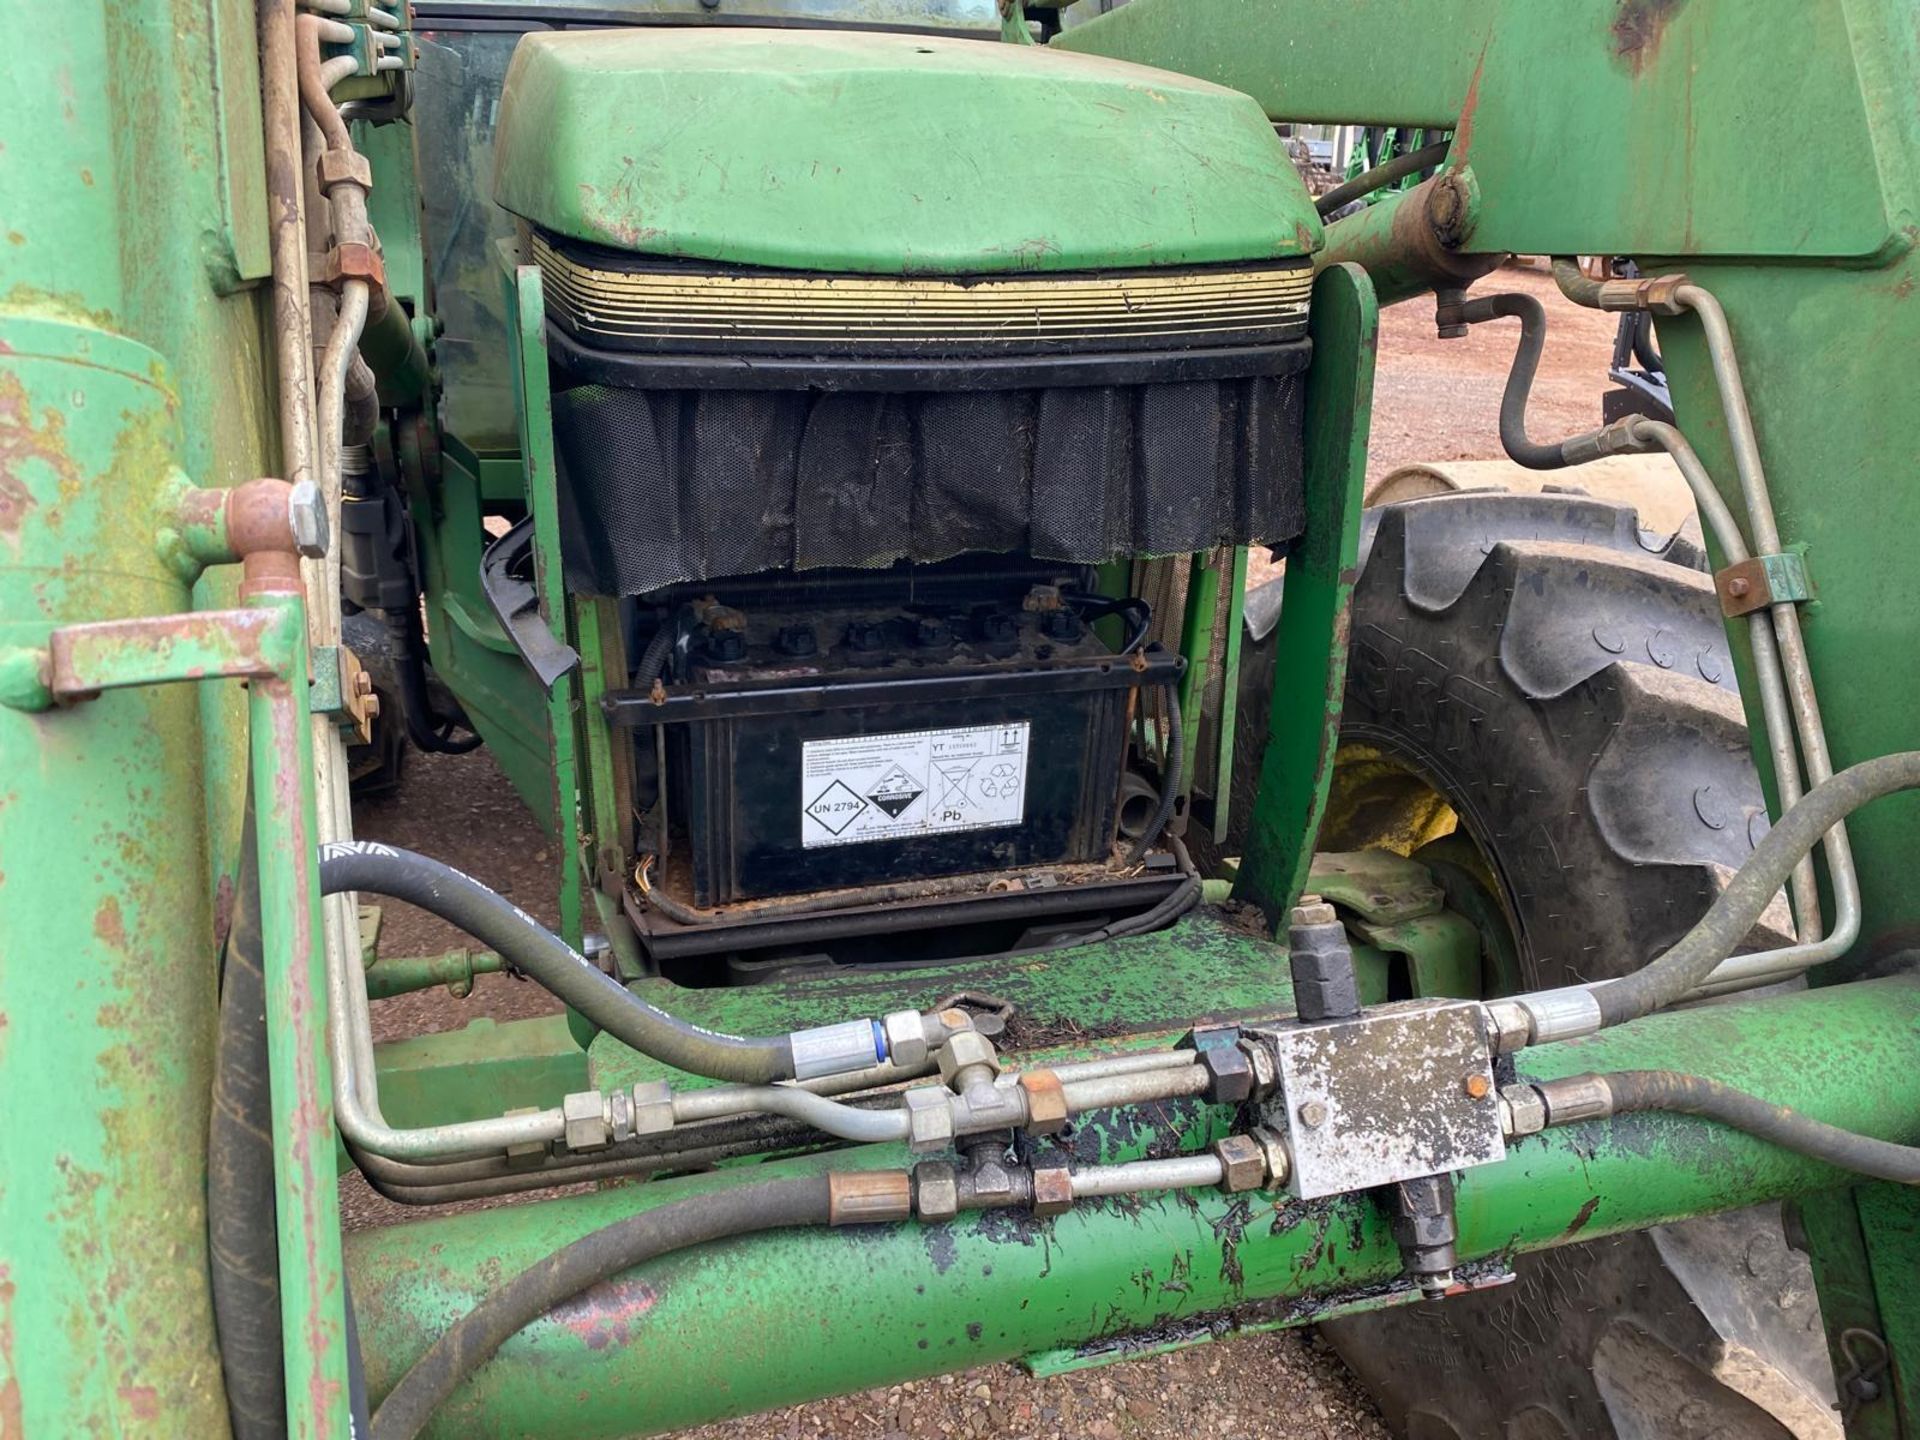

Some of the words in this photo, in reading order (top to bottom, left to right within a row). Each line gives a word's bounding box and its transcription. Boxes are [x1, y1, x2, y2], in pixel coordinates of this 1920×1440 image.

[932, 744, 945, 752] YT
[877, 792, 912, 802] CORROSIVE
[814, 804, 831, 814] UN
[834, 802, 860, 812] 2794
[943, 810, 962, 822] Pb
